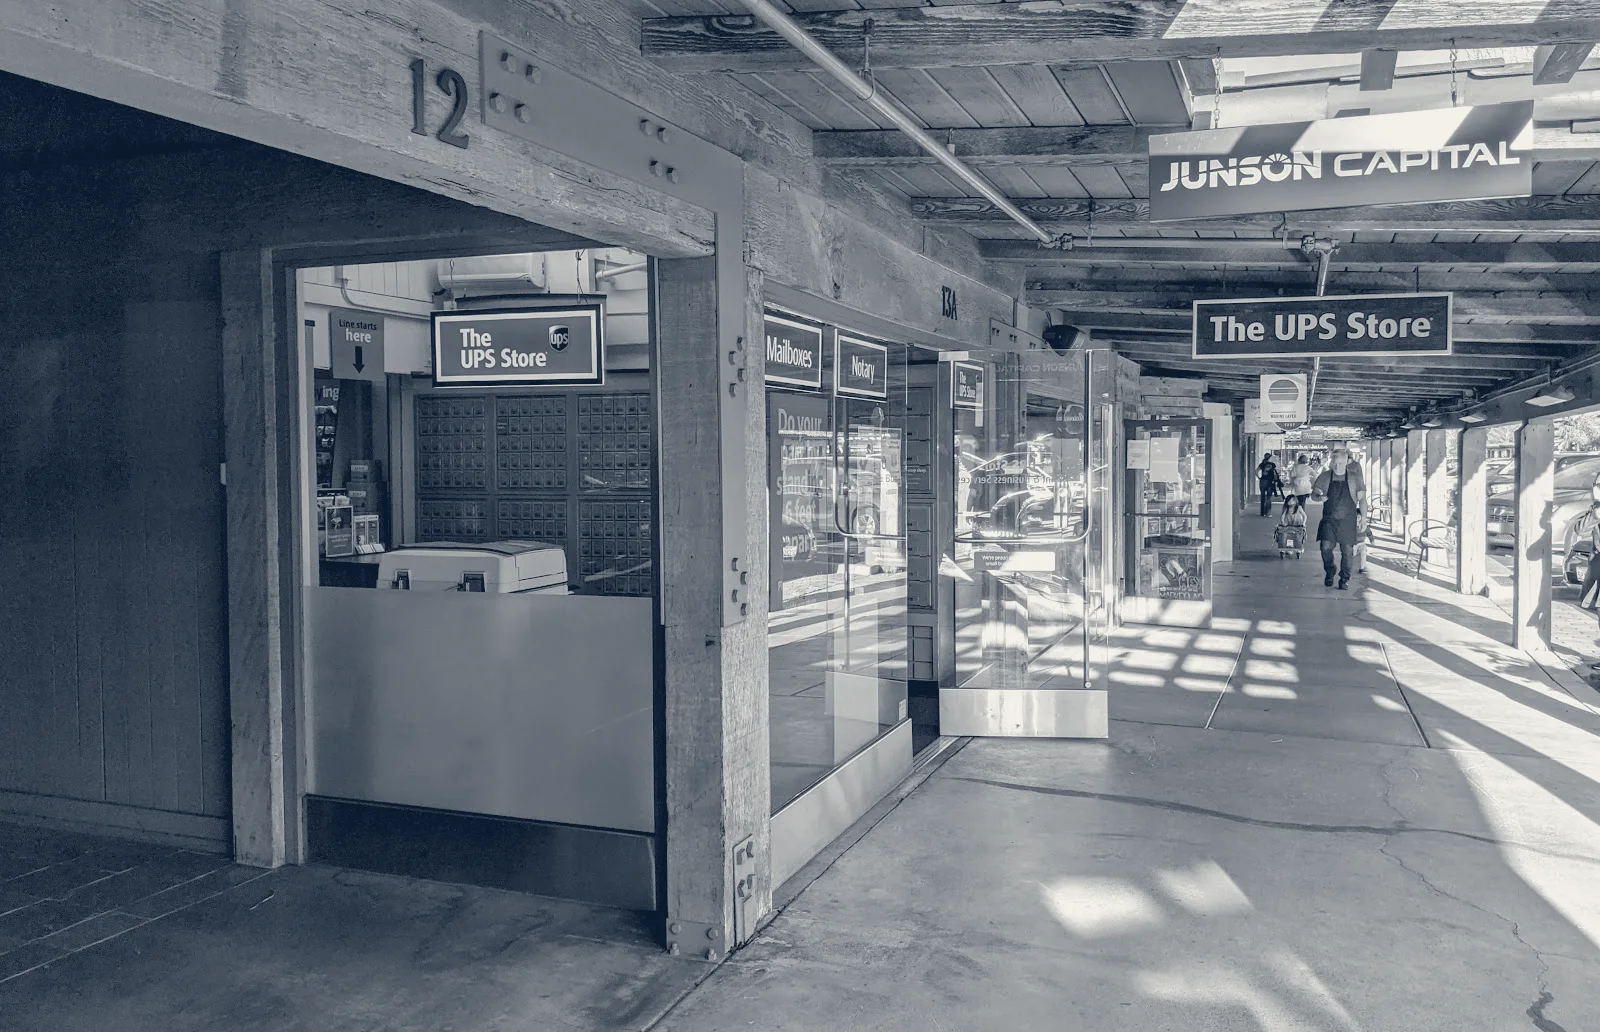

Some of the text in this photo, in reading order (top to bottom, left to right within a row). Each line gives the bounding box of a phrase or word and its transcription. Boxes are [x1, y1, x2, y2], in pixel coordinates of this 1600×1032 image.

[410, 58, 469, 149] 12
[1160, 141, 1521, 192] JUNSON CAPITAL
[941, 285, 958, 320] 13A
[339, 319, 377, 331] Line starts
[345, 328, 372, 343] here
[459, 328, 492, 348] The
[1209, 312, 1431, 342] The UPS Store
[550, 333, 568, 349] ups
[766, 335, 813, 368] Mailboxes
[460, 348, 547, 369] UPS Store
[851, 354, 875, 385] Notary
[778, 408, 822, 441] Do your
